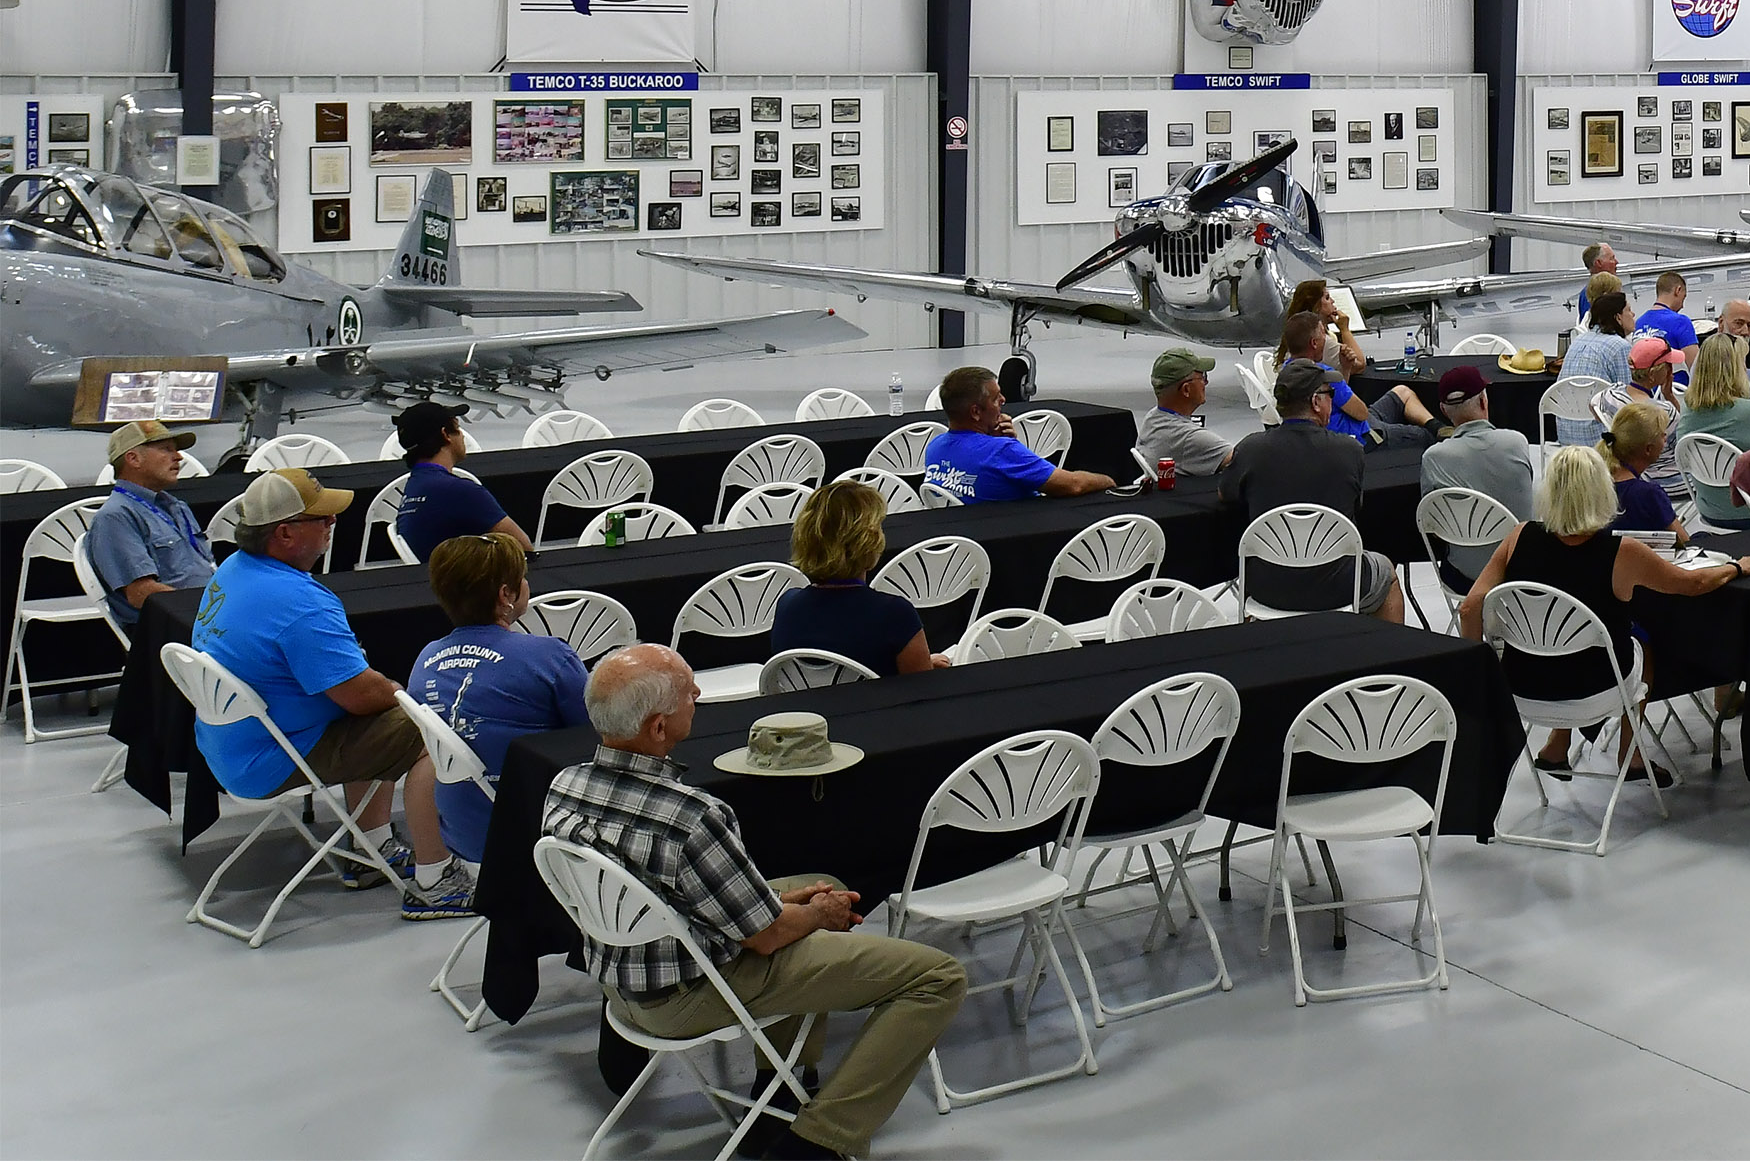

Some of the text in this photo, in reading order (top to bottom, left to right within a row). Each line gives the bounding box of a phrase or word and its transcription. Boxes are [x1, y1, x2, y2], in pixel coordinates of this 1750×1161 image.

[527, 76, 683, 88] TEMCO T-35 BUCKAROO
[1205, 76, 1282, 87] TEMCO SWIFT
[1681, 74, 1739, 84] GLOBE SWIFT
[401, 253, 448, 286] 34466
[924, 464, 966, 488] Swift
[424, 645, 504, 669] McMINN COUNTY
[437, 658, 480, 671] AIRPORT
